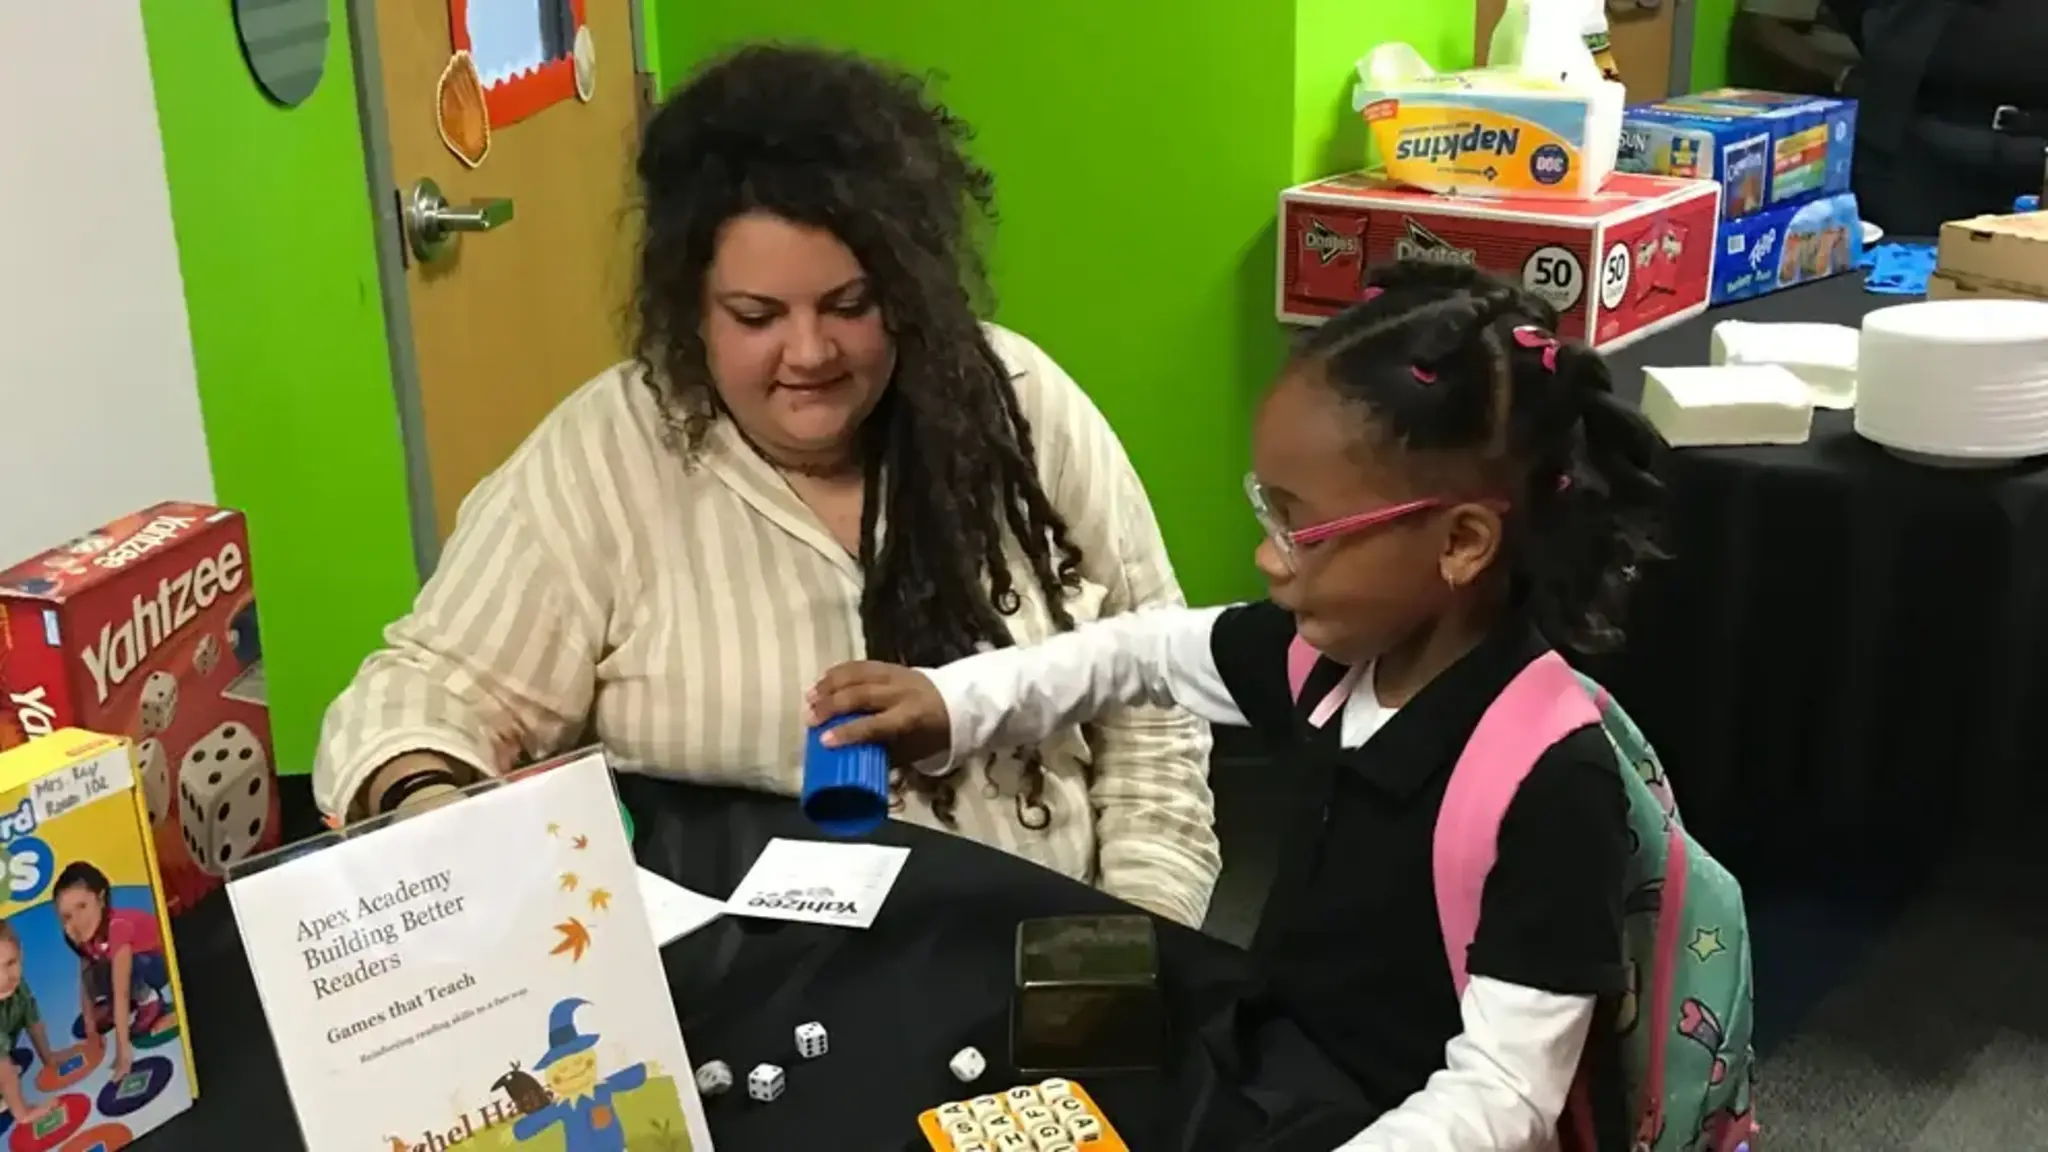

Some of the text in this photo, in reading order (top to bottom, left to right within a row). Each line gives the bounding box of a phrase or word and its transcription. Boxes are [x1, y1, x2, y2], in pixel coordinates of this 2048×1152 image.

[1396, 123, 1520, 163] Napkins
[1305, 232, 1357, 254] Doritos
[1535, 257, 1571, 288] 50
[1607, 254, 1625, 284] 50
[93, 516, 196, 568] Yahtzee
[81, 543, 243, 704] Yahtzee
[297, 869, 451, 942] Apex Academy
[748, 897, 858, 914] Yahtzee
[303, 896, 464, 971] Building Better
[312, 952, 402, 1000] Readers
[327, 972, 477, 1044] Games that Teach
